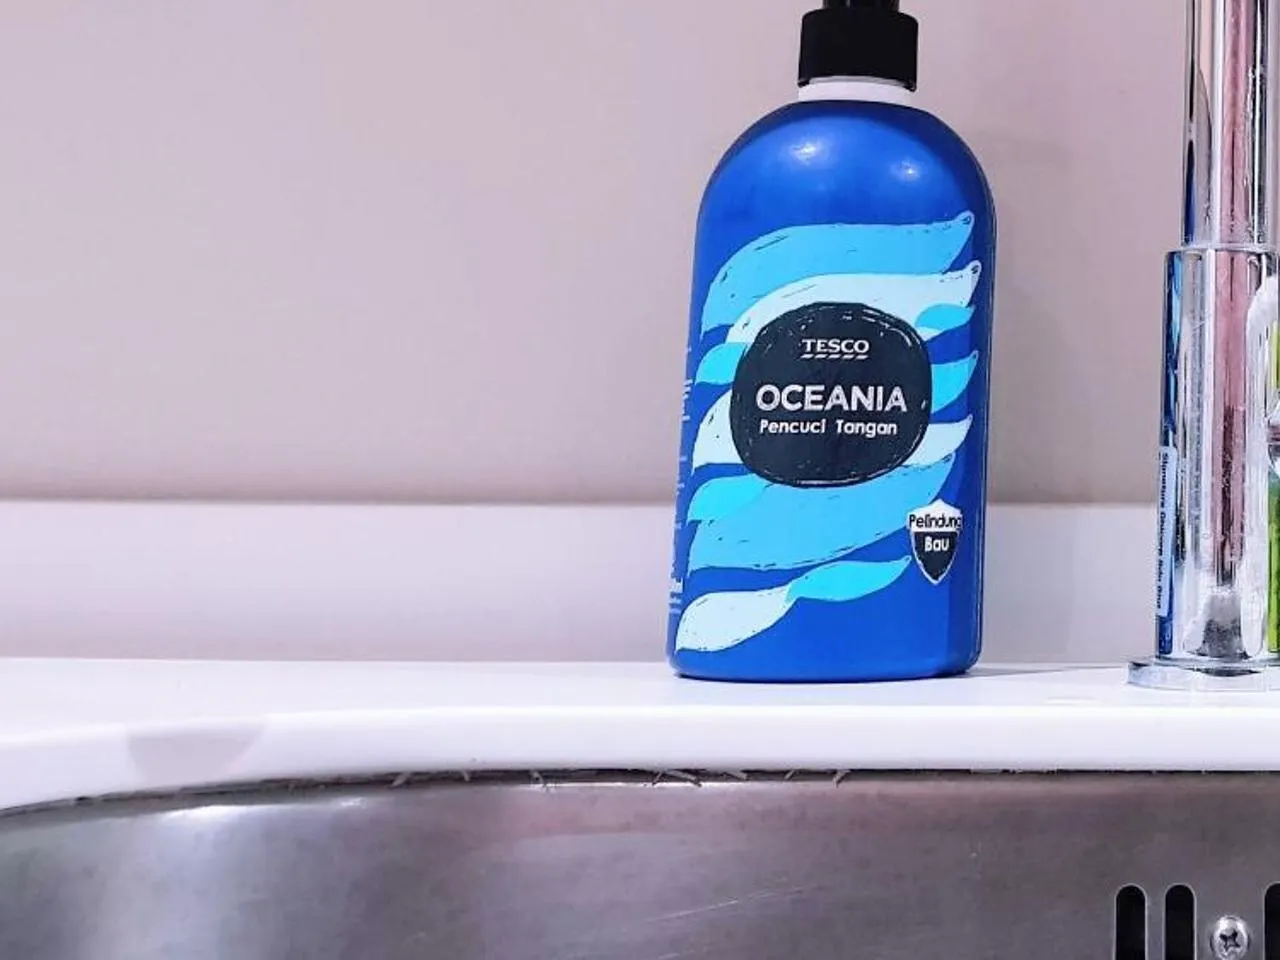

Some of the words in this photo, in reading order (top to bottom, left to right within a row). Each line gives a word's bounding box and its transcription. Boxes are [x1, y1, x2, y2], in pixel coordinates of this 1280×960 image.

[801, 339, 869, 353] TESCO
[756, 384, 908, 412] OCEANIA
[759, 418, 826, 434] Pencuci
[836, 419, 897, 438] Tangan
[924, 536, 950, 552] Bau
